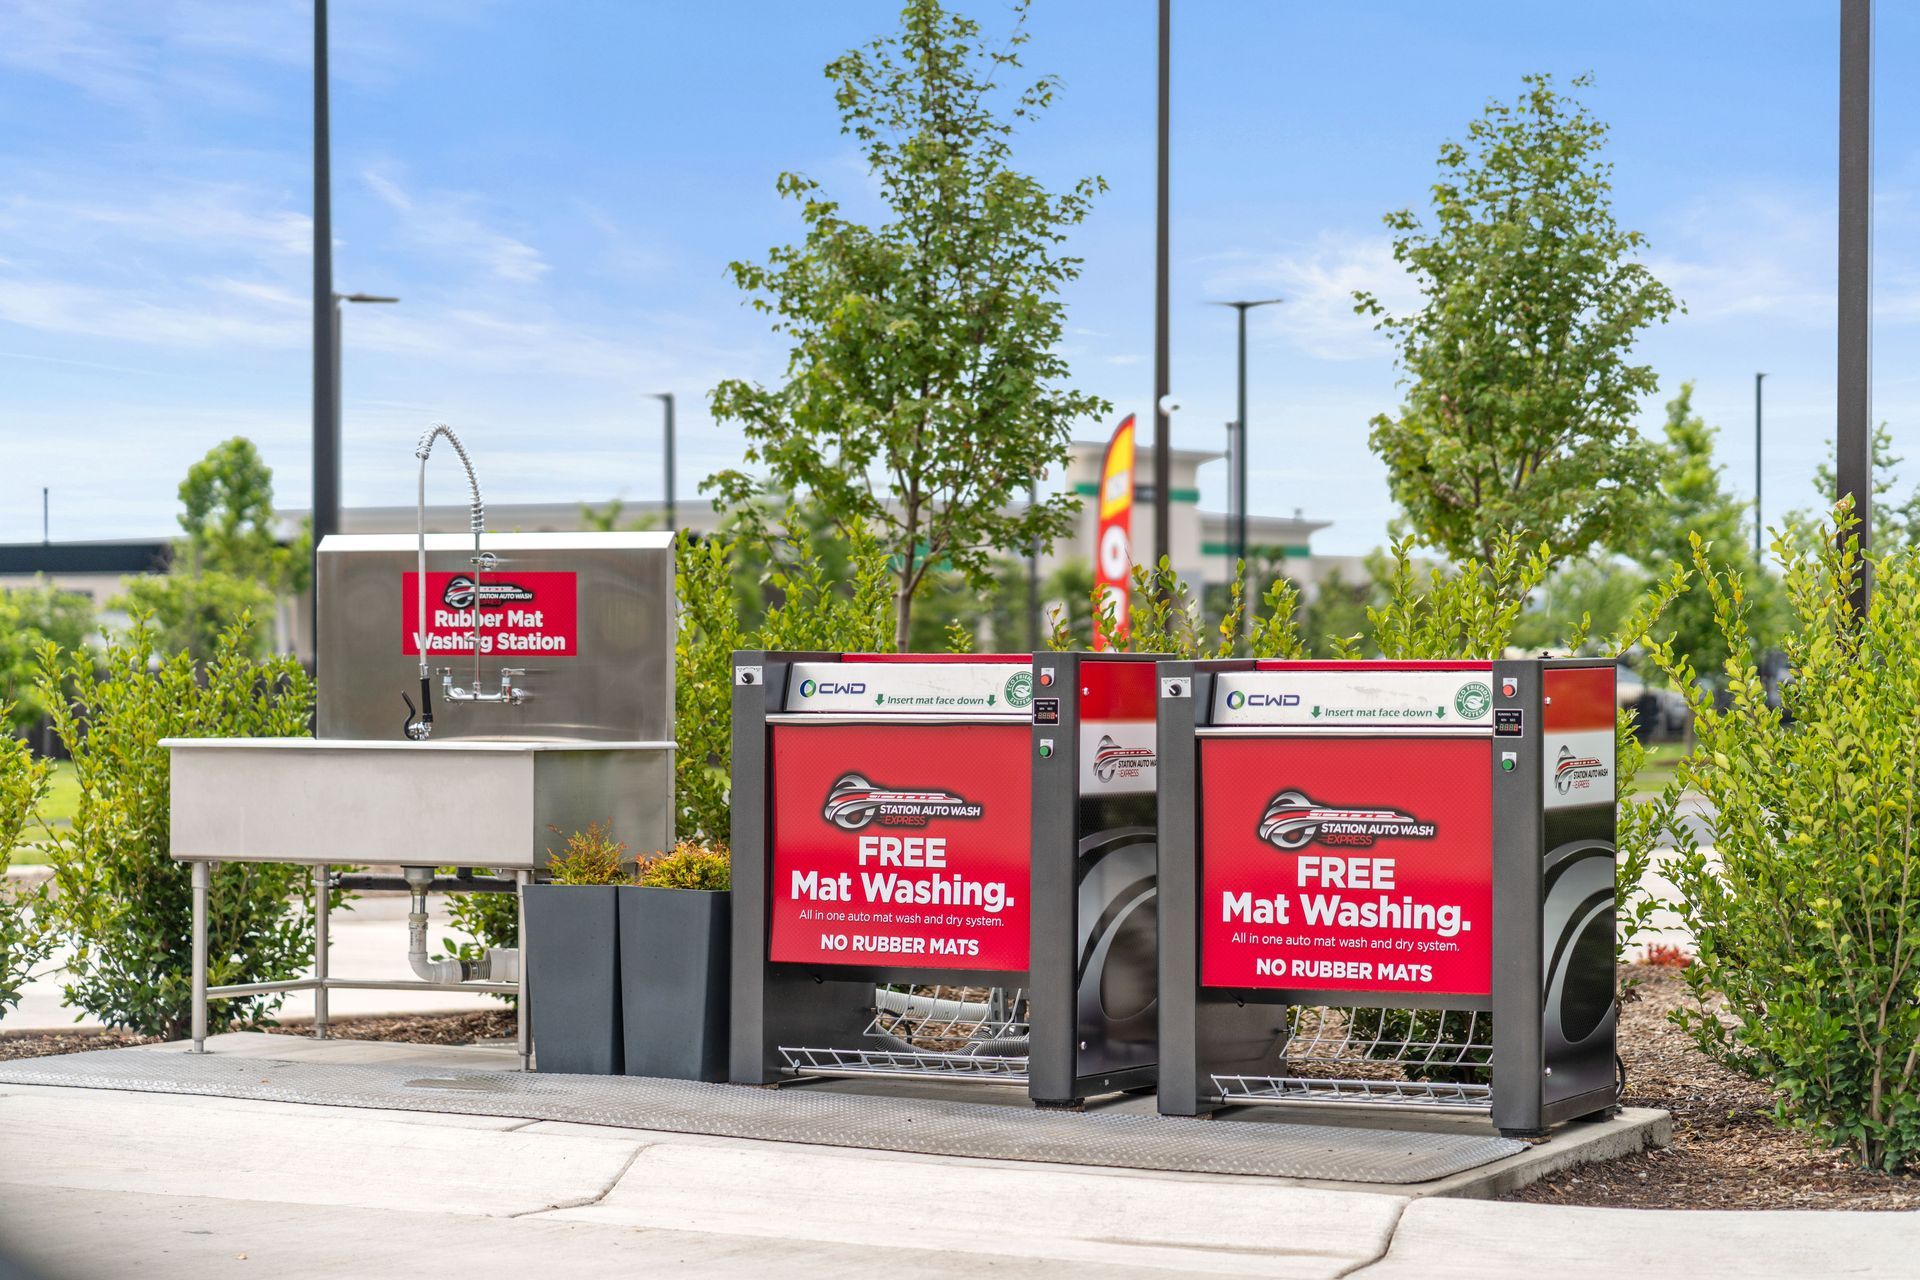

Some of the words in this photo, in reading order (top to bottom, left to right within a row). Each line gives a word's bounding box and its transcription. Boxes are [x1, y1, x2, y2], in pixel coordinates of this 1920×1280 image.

[434, 610, 504, 627] Rubber
[507, 610, 544, 627] Mat
[497, 632, 566, 650] Station
[818, 683, 866, 694] CWD
[1467, 684, 1489, 701] FRIENDLY
[887, 696, 914, 705] Insert
[915, 696, 934, 705] mat
[935, 696, 956, 705] face
[957, 697, 985, 705] down
[1247, 694, 1300, 706] CWD
[1325, 708, 1354, 717] Insert
[1356, 708, 1376, 717] mat
[1378, 708, 1400, 717] face
[1402, 708, 1433, 717] down
[1461, 709, 1484, 717] SYSTEM
[1118, 760, 1136, 768] STATION
[1120, 769, 1139, 777] EXPRESS
[880, 805, 921, 815] STATION
[922, 806, 949, 815] AUTO
[950, 806, 981, 816] WASH
[885, 816, 926, 825] EXPRESS
[1321, 823, 1366, 834] STATION
[1368, 824, 1399, 835] AUTO
[1400, 825, 1434, 836] WASH
[1327, 835, 1372, 845] EXPRESS
[858, 836, 947, 868] FREE
[1297, 856, 1396, 890] FREE
[791, 870, 852, 901] Mat
[861, 872, 1015, 912] Washing.
[799, 909, 812, 920] All
[815, 910, 824, 920] in
[826, 912, 845, 921] one
[847, 911, 871, 922] auto
[873, 912, 893, 923] mat
[895, 913, 921, 924] wash
[923, 914, 943, 925] and
[945, 914, 963, 927] dry
[965, 916, 1005, 928] system.
[1222, 891, 1290, 925] Mat
[1299, 893, 1472, 937] Washing.
[820, 934, 848, 951] NO
[852, 935, 925, 954] RUBBER
[929, 938, 979, 956] MATS
[1231, 932, 1246, 943] All
[1249, 933, 1259, 944] in
[1262, 935, 1283, 945] one
[1285, 935, 1311, 946] auto
[1314, 936, 1336, 947] mat
[1339, 937, 1368, 948] wash
[1371, 938, 1392, 949] and
[1395, 938, 1414, 951] dry
[1417, 941, 1460, 952] system.
[1256, 958, 1287, 976] NO
[1292, 960, 1373, 980] RUBBER
[1377, 963, 1433, 983] MATS
